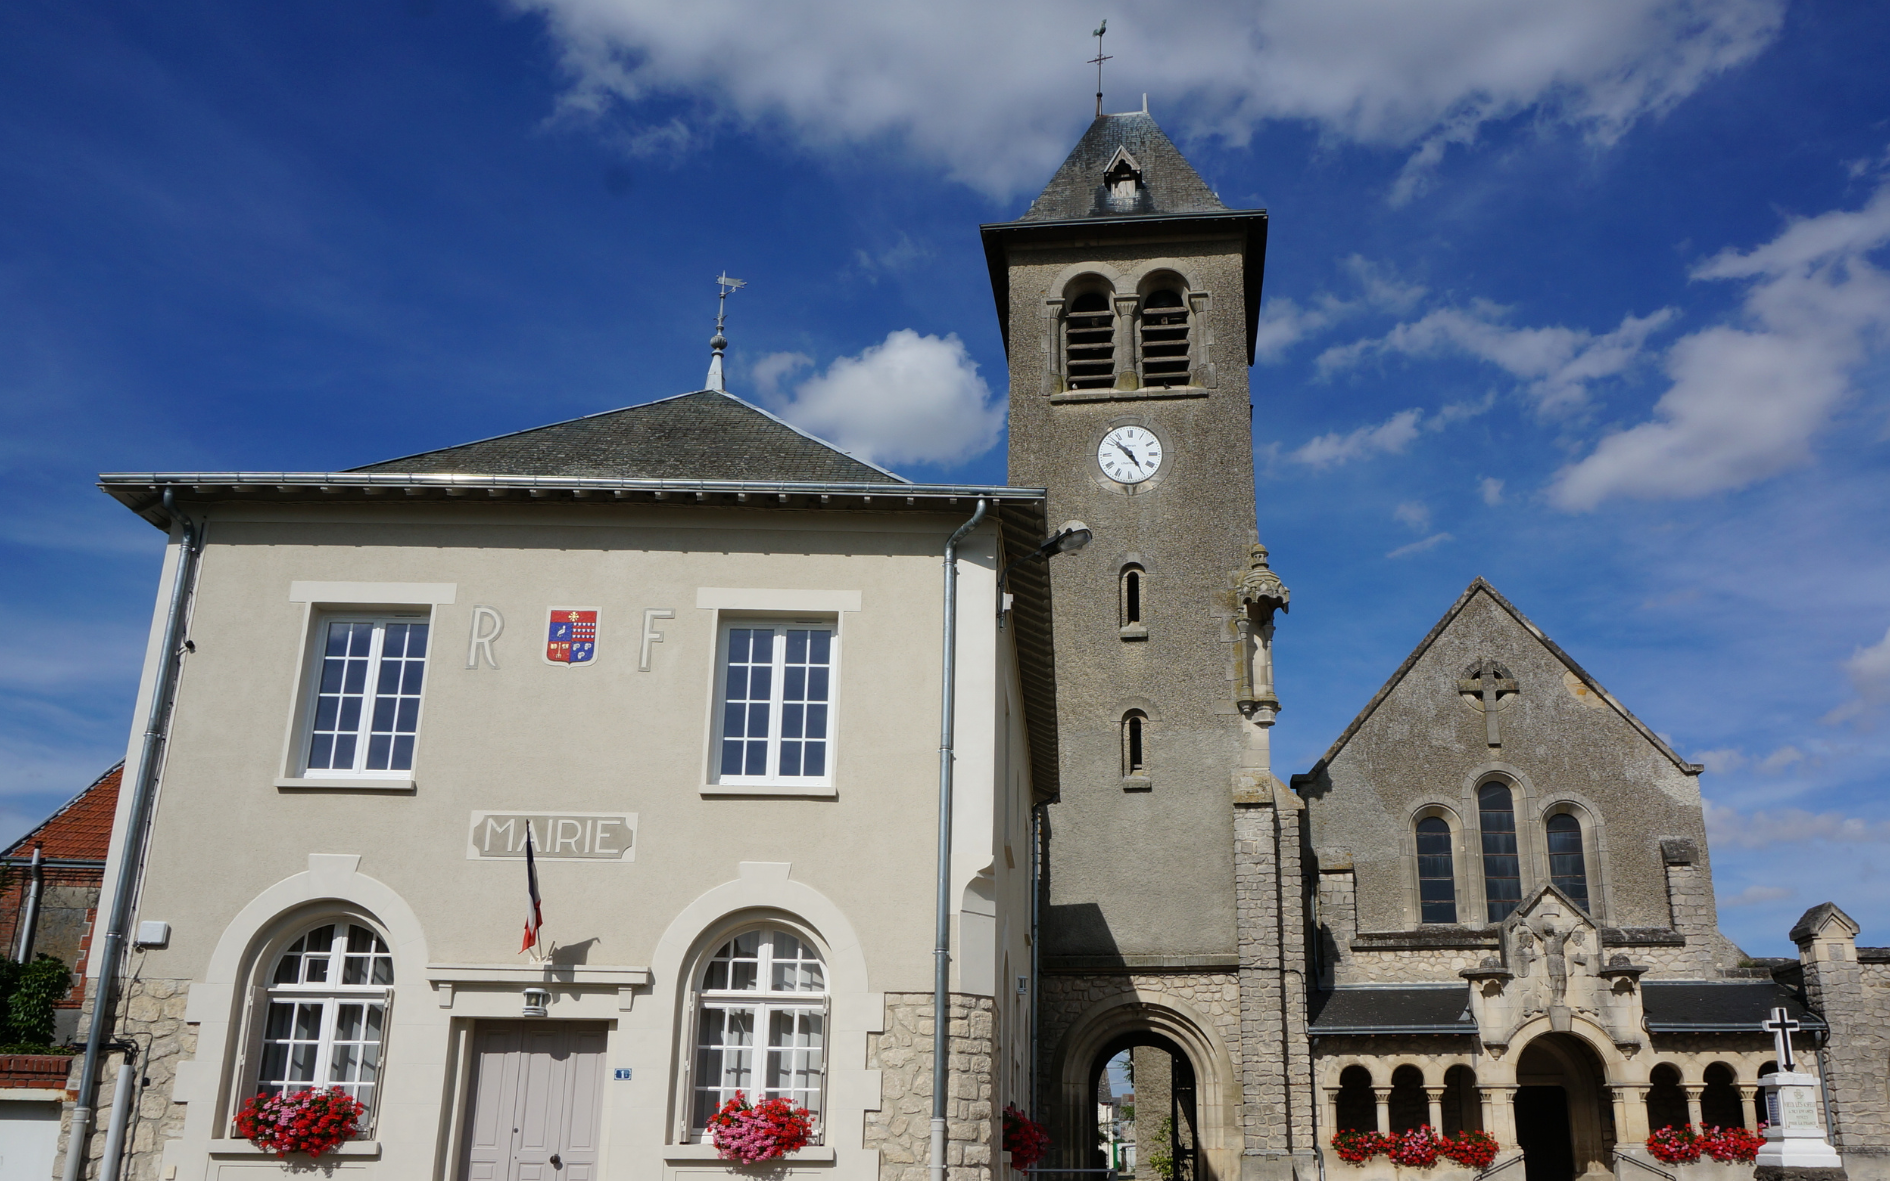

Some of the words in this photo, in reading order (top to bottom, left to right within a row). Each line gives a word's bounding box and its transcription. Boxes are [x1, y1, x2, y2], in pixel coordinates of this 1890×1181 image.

[465, 604, 505, 670] R
[638, 607, 676, 672] F
[484, 817, 621, 854] MAIRIE
